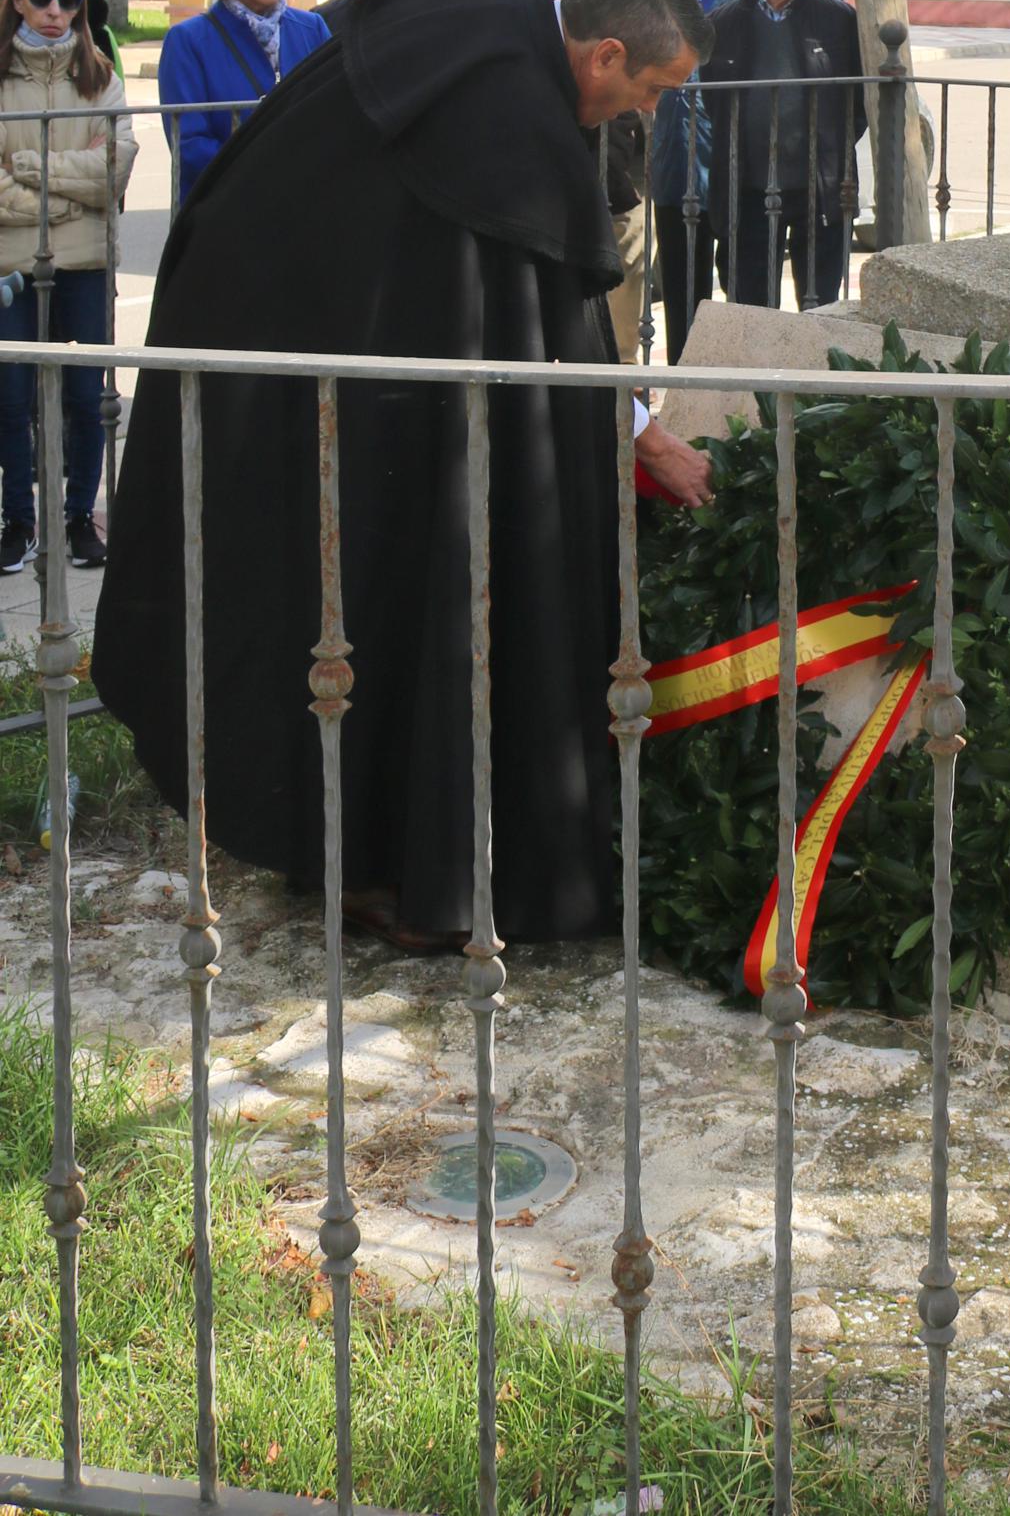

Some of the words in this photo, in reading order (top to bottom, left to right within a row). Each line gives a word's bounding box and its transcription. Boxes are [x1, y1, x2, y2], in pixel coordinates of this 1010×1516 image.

[656, 679, 728, 712] SOCIOS
[829, 674, 911, 804] COOPERATIVA
[810, 811, 836, 850] DEL
